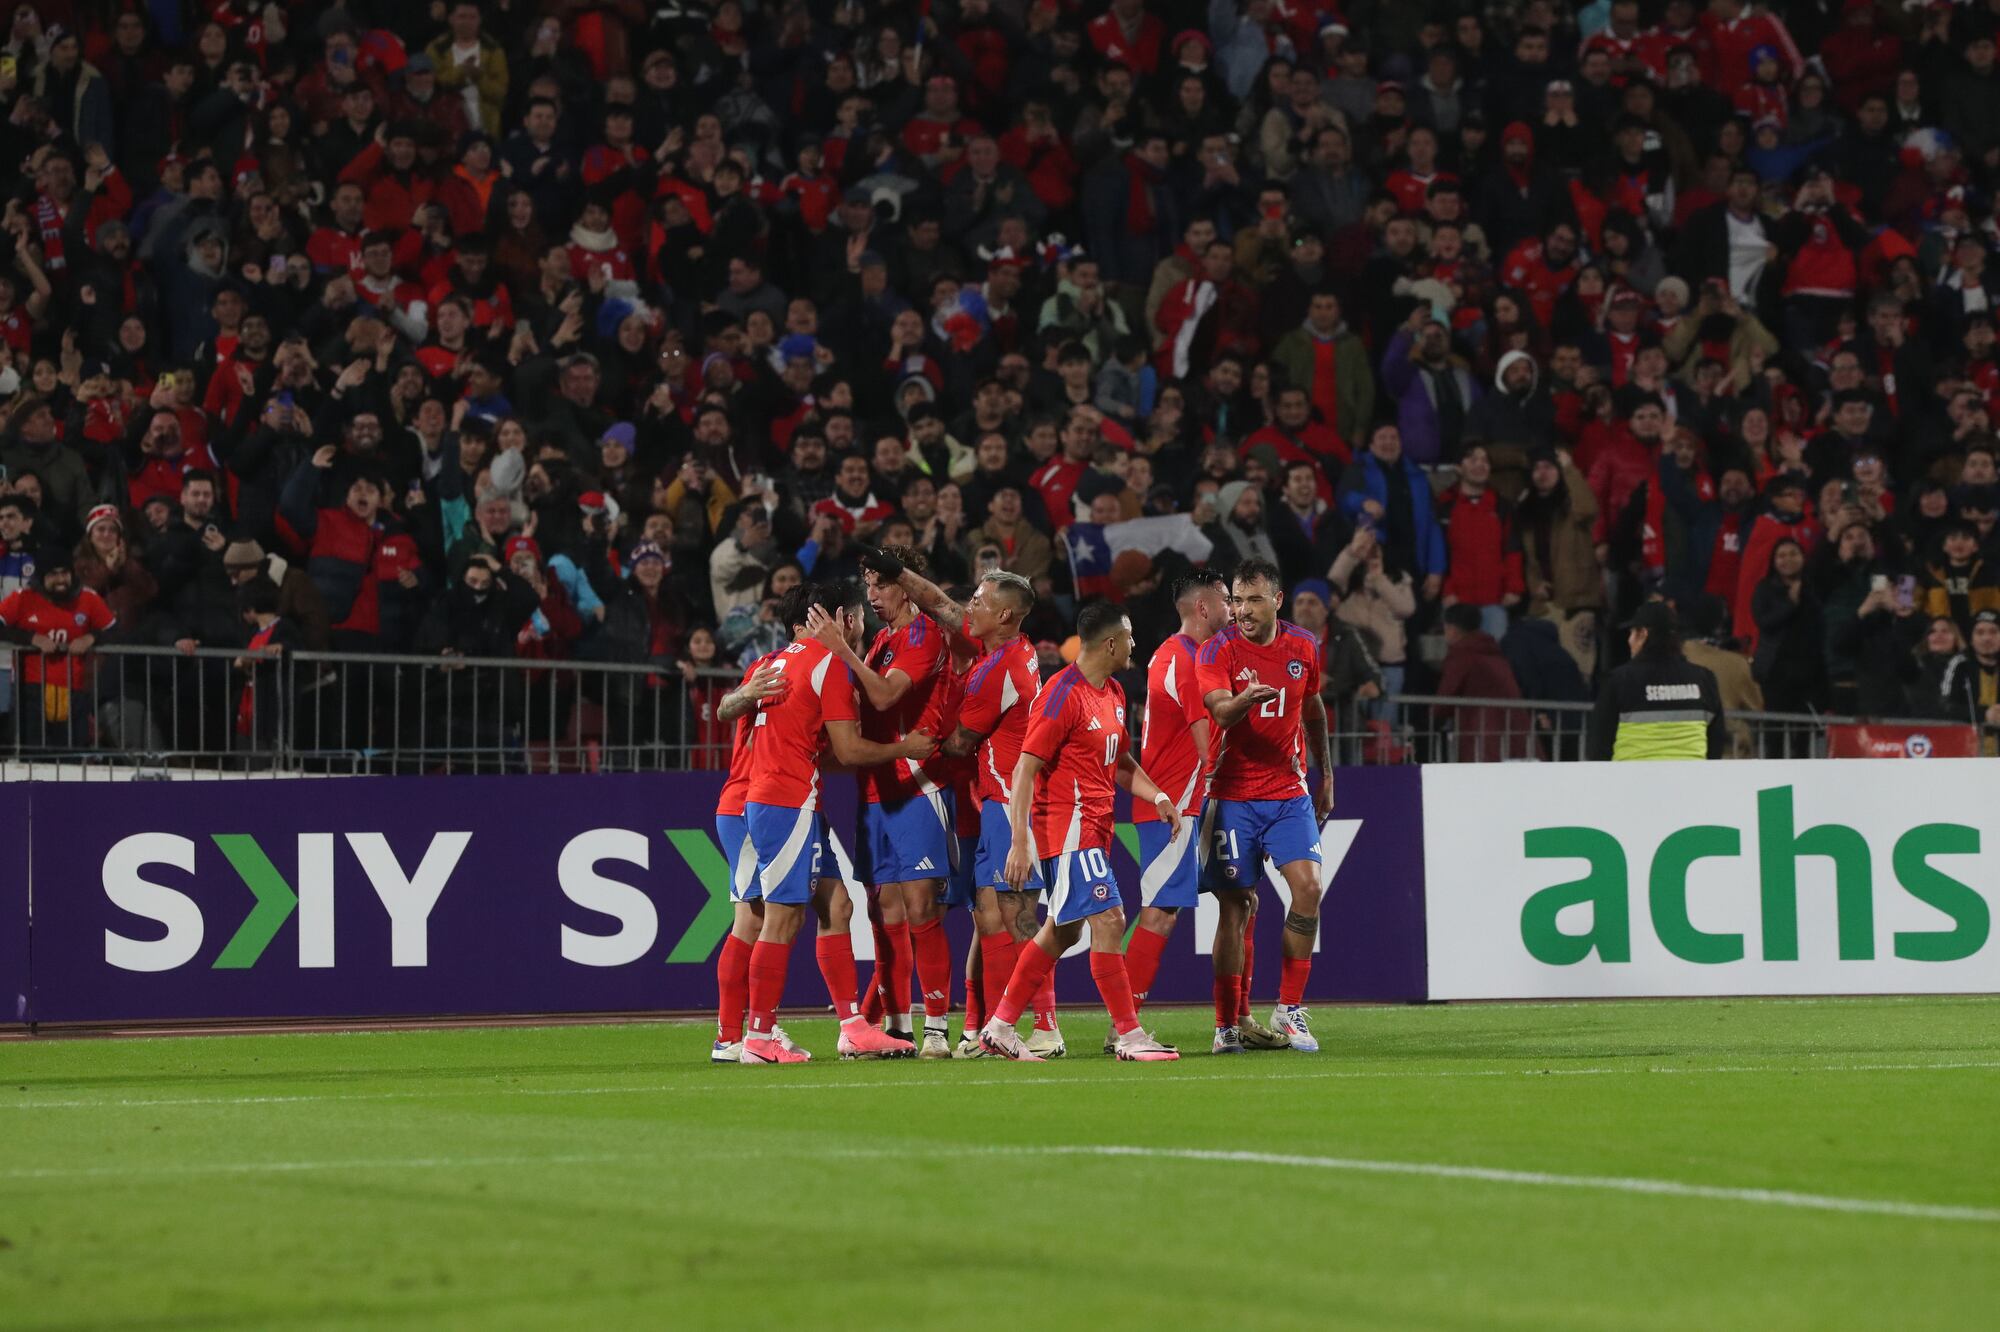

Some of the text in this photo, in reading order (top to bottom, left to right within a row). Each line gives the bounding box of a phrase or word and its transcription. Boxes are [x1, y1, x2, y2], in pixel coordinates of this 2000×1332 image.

[1260, 687, 1288, 719] 21
[1645, 683, 1702, 701] SEGURIDAD
[1103, 733, 1120, 767] 10
[811, 842, 822, 873] 2
[1213, 829, 1240, 860] 21
[1078, 847, 1109, 883] 10
[1520, 786, 1990, 965] achs
